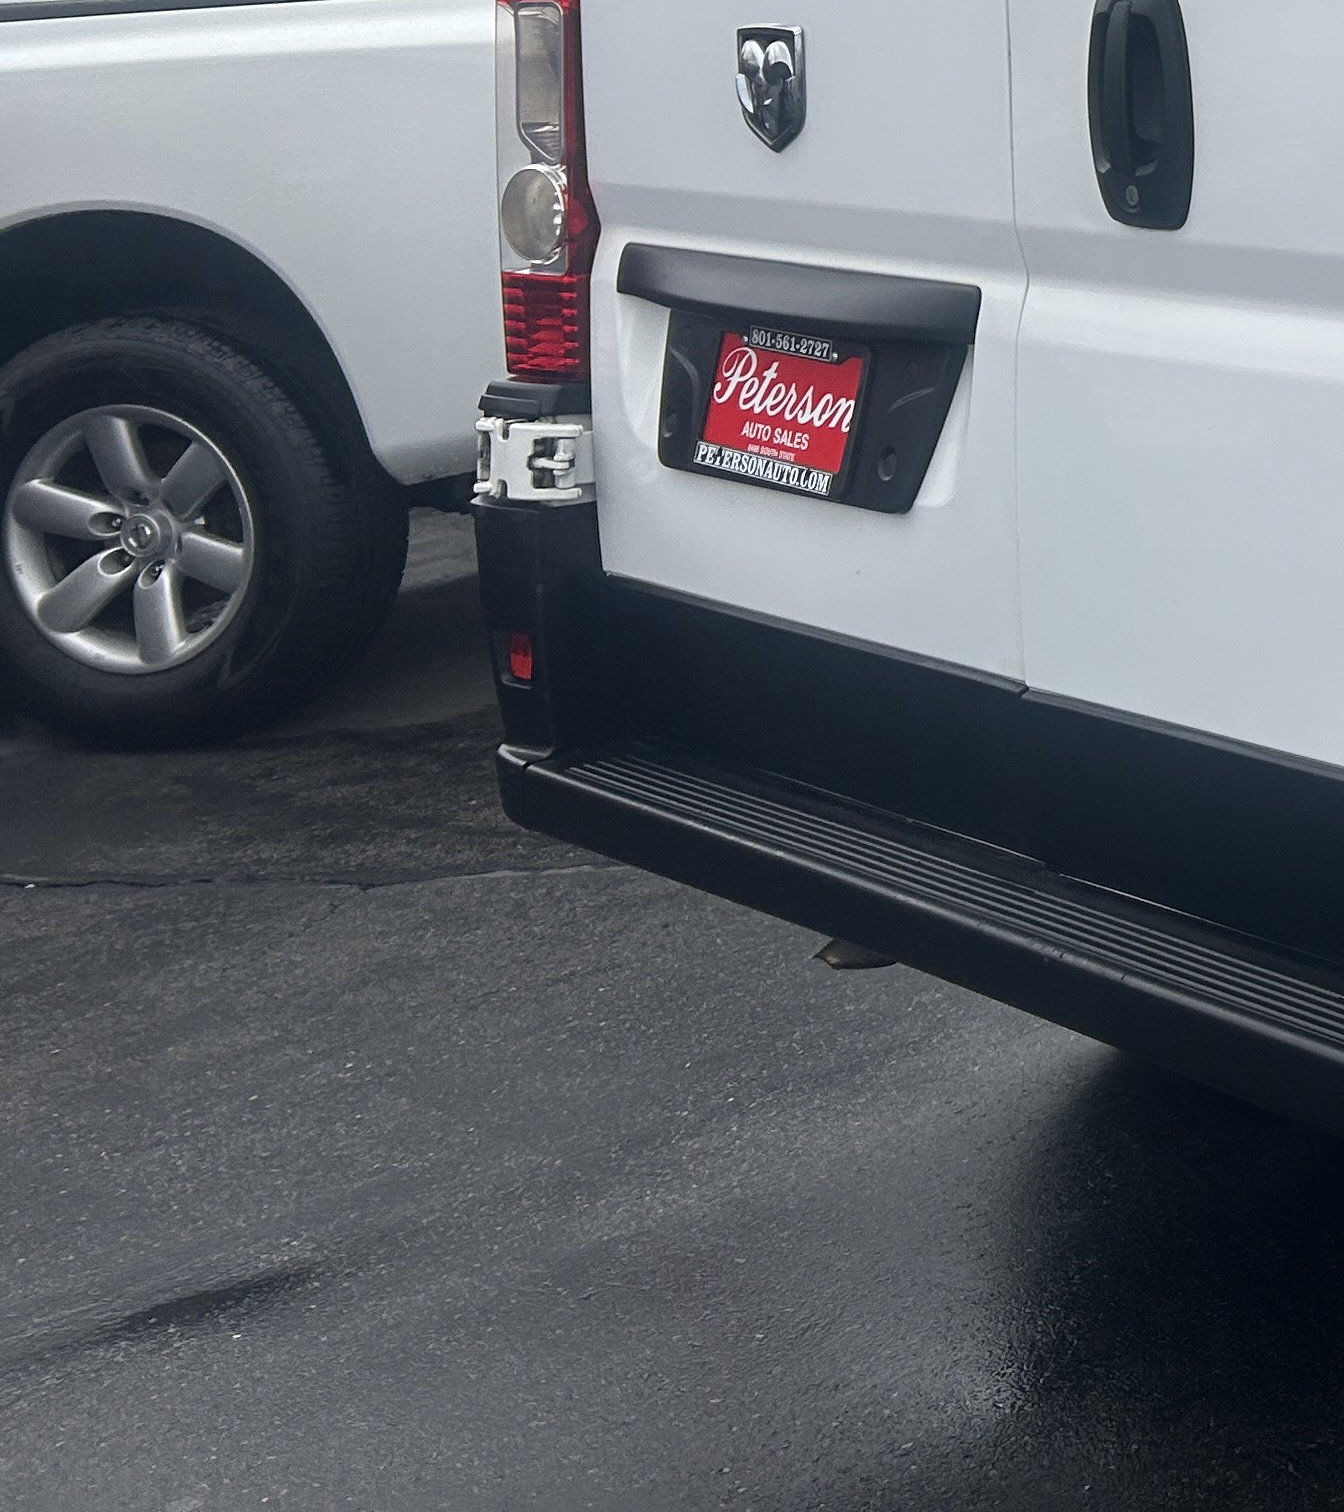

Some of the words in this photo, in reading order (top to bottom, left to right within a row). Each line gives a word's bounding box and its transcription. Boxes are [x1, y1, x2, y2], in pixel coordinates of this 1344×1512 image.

[712, 346, 857, 434] Peterson
[741, 420, 771, 442] AUTO
[773, 427, 810, 451] SALES
